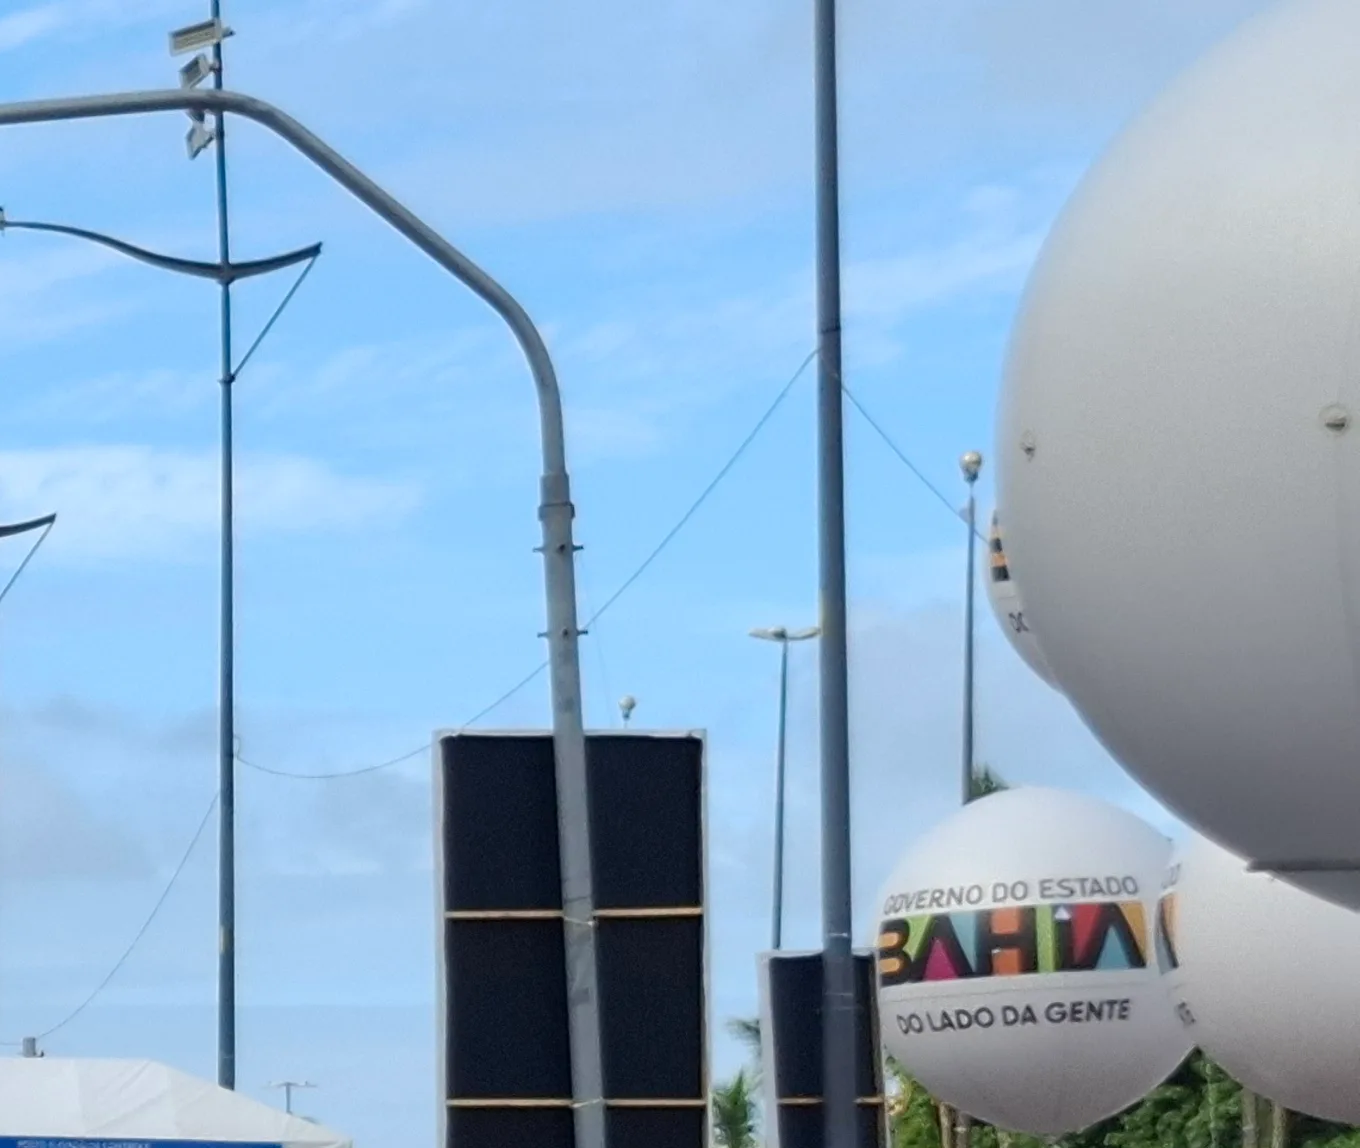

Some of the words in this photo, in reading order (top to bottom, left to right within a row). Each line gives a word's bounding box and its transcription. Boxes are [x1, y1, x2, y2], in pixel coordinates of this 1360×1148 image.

[884, 884, 981, 915] GOVERNO
[992, 880, 1028, 903] DO
[1039, 875, 1139, 899] ESTADO
[878, 902, 1147, 986] BAHIA
[896, 1013, 924, 1035] DO
[930, 1005, 995, 1033] LADO
[1002, 1003, 1037, 1027] DA
[1045, 998, 1131, 1024] GENTE
